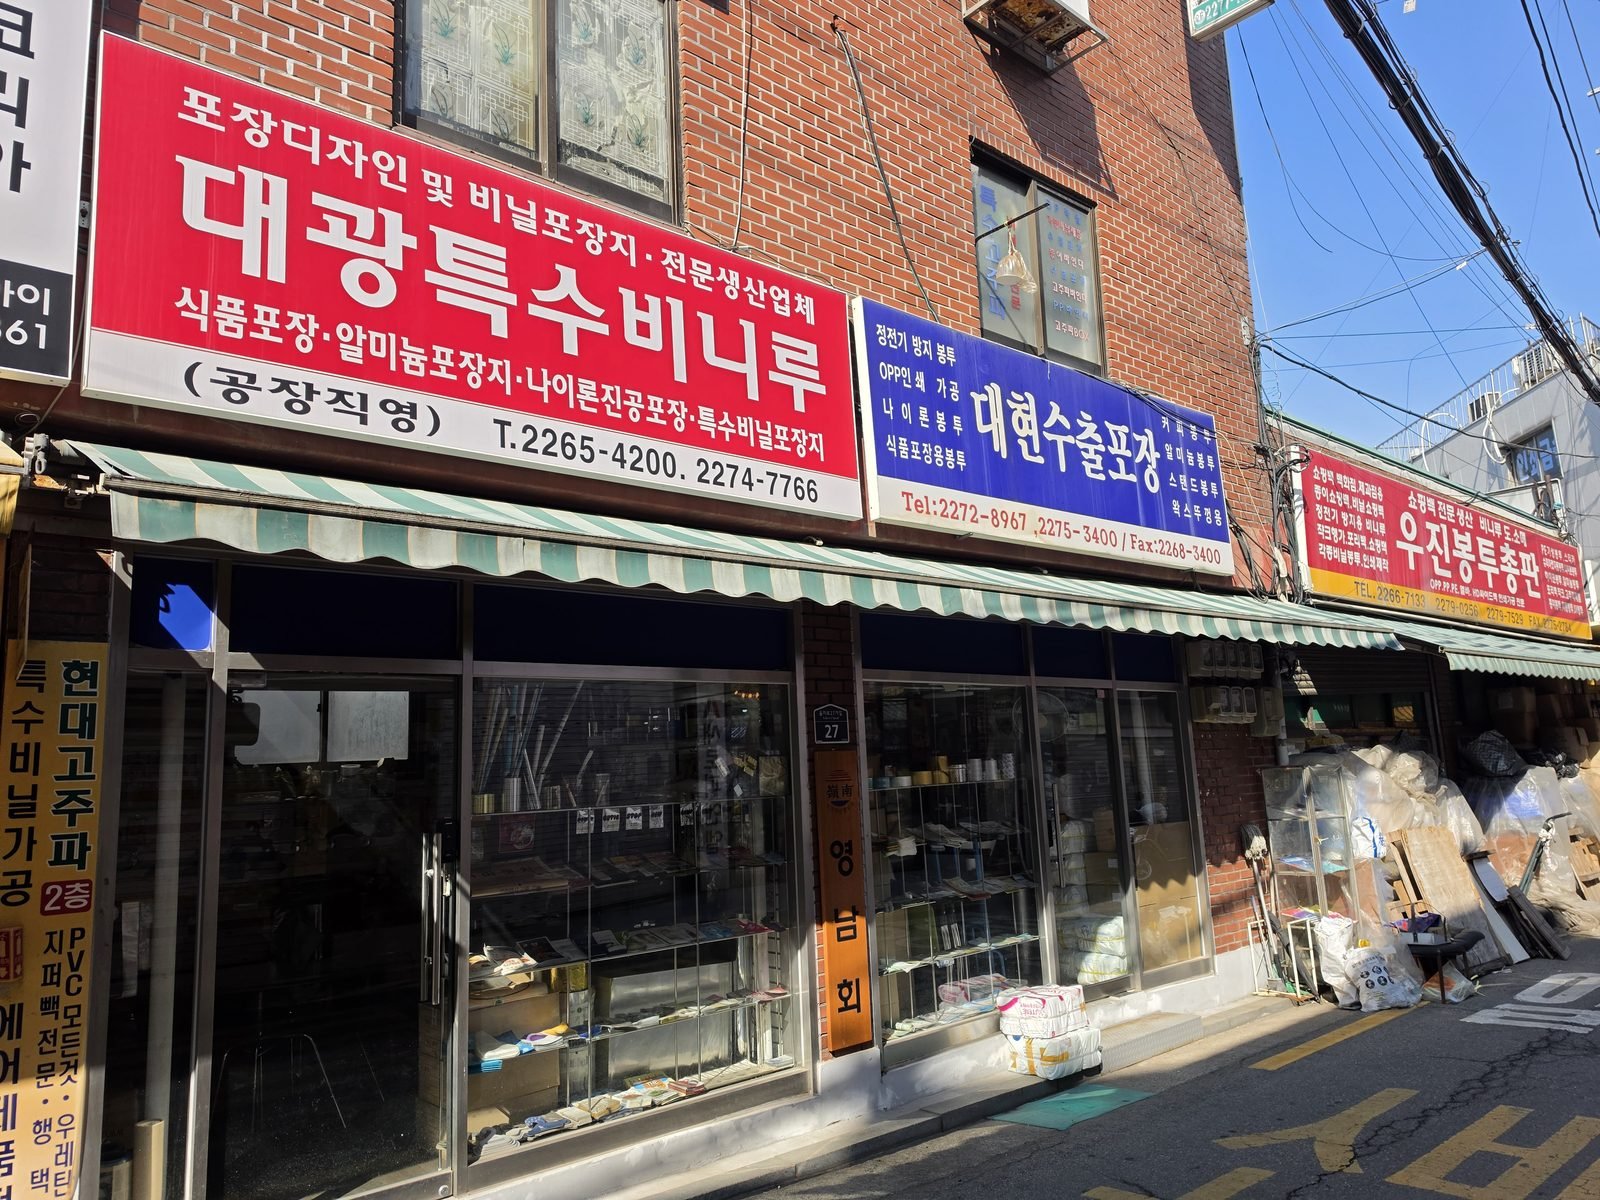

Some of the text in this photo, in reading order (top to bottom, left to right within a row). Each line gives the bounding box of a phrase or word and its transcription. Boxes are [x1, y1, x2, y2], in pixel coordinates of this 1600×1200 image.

[177, 85, 407, 193] 포장디자인
[422, 167, 453, 208] 및
[175, 155, 827, 413] 대광특수비니루
[876, 323, 957, 367] 정전기 방지 봉투
[183, 361, 441, 437] (공장직영)
[886, 433, 967, 472] 식품포장용봉투
[969, 381, 1162, 495] 대현수출포장
[696, 457, 819, 503] 2274-7766
[1313, 465, 1335, 486] 쇼핑백
[1315, 504, 1386, 537] 정전기 방지용 비니루
[1407, 490, 1437, 517] 쇼핑백
[1479, 515, 1503, 539] 비니루
[1396, 511, 1542, 599] 우진봉투총판
[1435, 597, 1479, 617] 2279-0256
[824, 724, 839, 739] 27
[47, 659, 99, 870] 현대고주파
[44, 881, 91, 912] 2층
